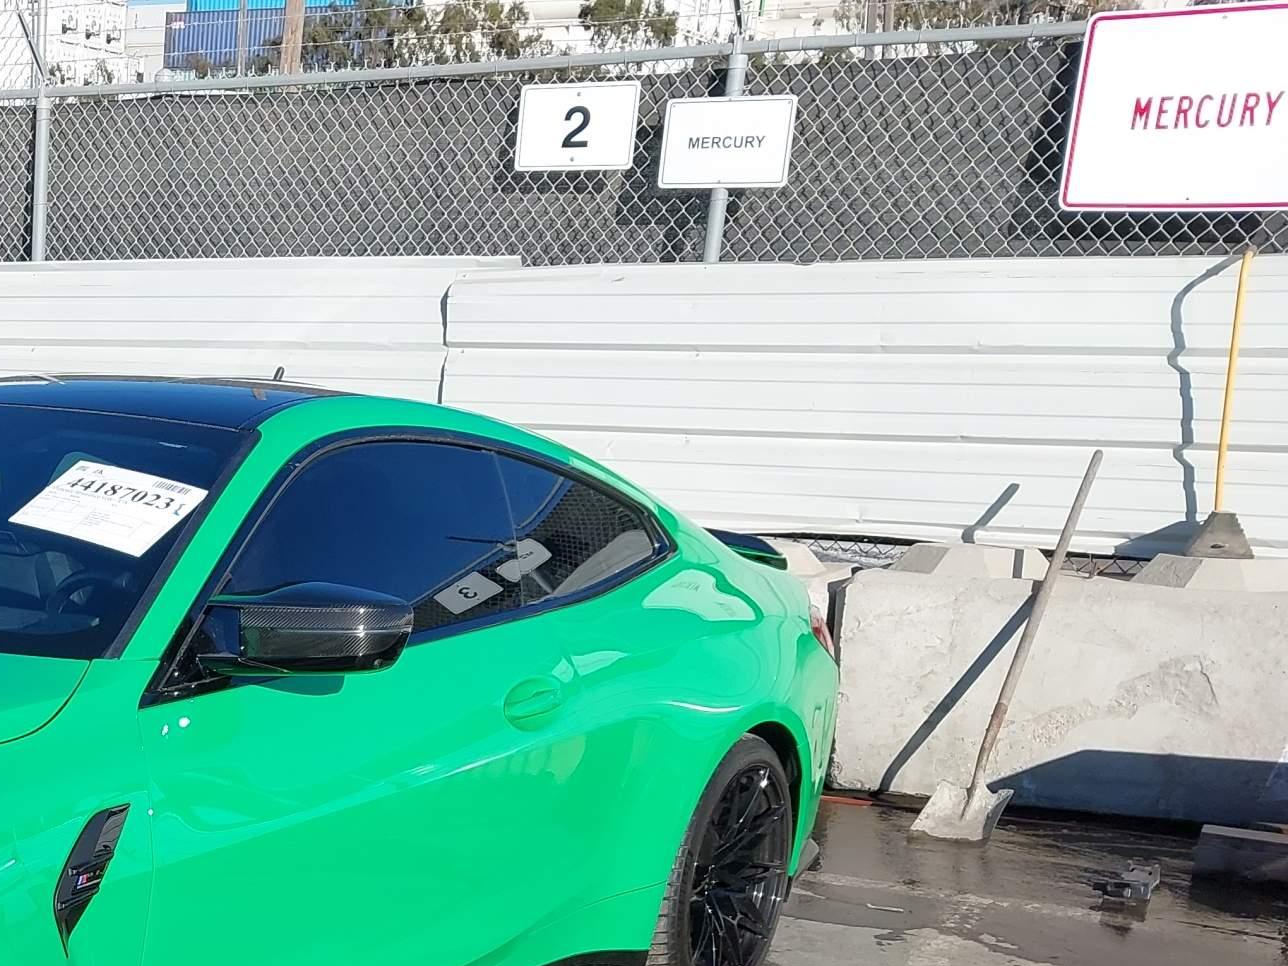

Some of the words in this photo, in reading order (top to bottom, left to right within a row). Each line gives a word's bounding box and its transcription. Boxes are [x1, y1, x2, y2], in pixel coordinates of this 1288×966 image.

[561, 105, 591, 149] 2
[1130, 91, 1285, 130] MERCURY
[688, 135, 765, 149] MERCURY
[67, 477, 175, 510] 44187023
